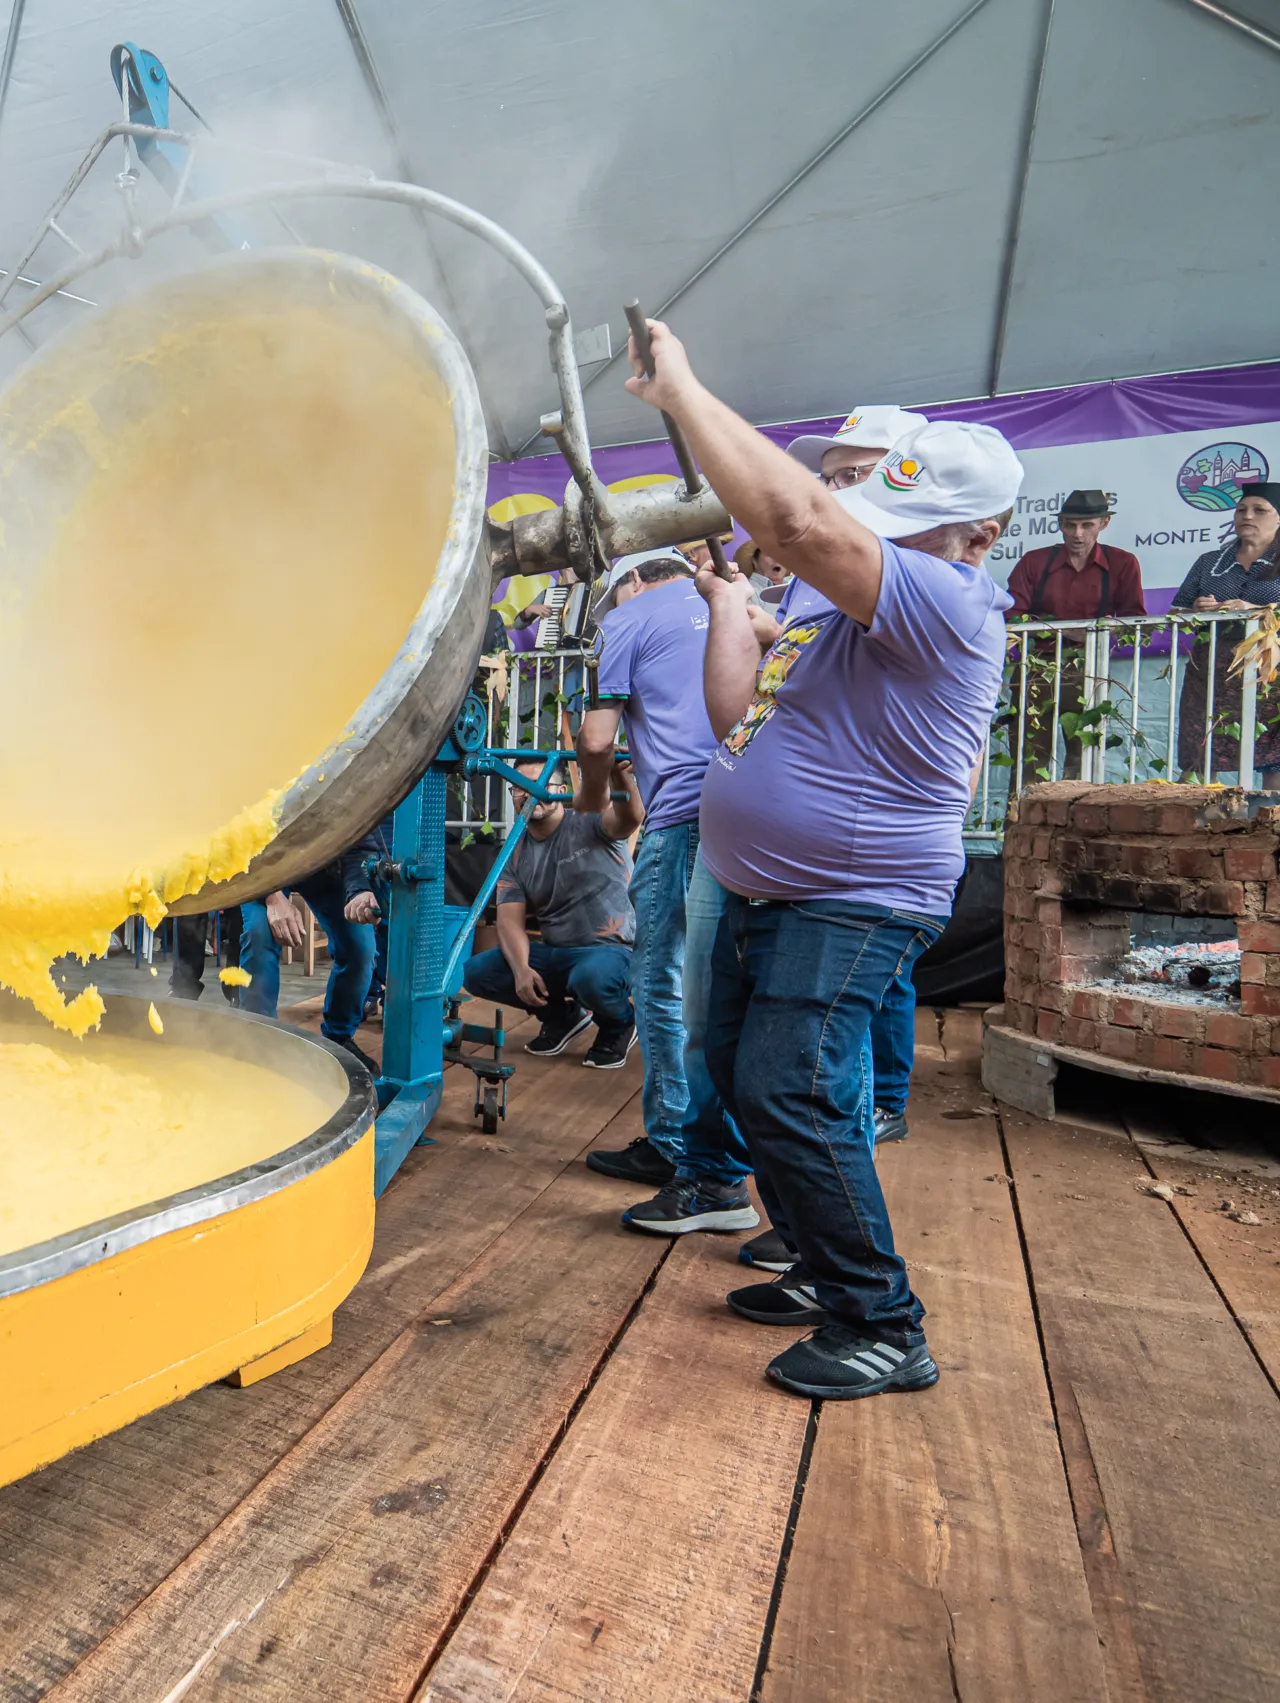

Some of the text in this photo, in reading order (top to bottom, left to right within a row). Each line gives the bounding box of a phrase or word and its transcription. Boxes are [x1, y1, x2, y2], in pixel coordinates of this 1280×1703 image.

[1016, 492, 1117, 514] Tradis
[1135, 528, 1211, 547] MONTE
[990, 541, 1023, 560] Sul
